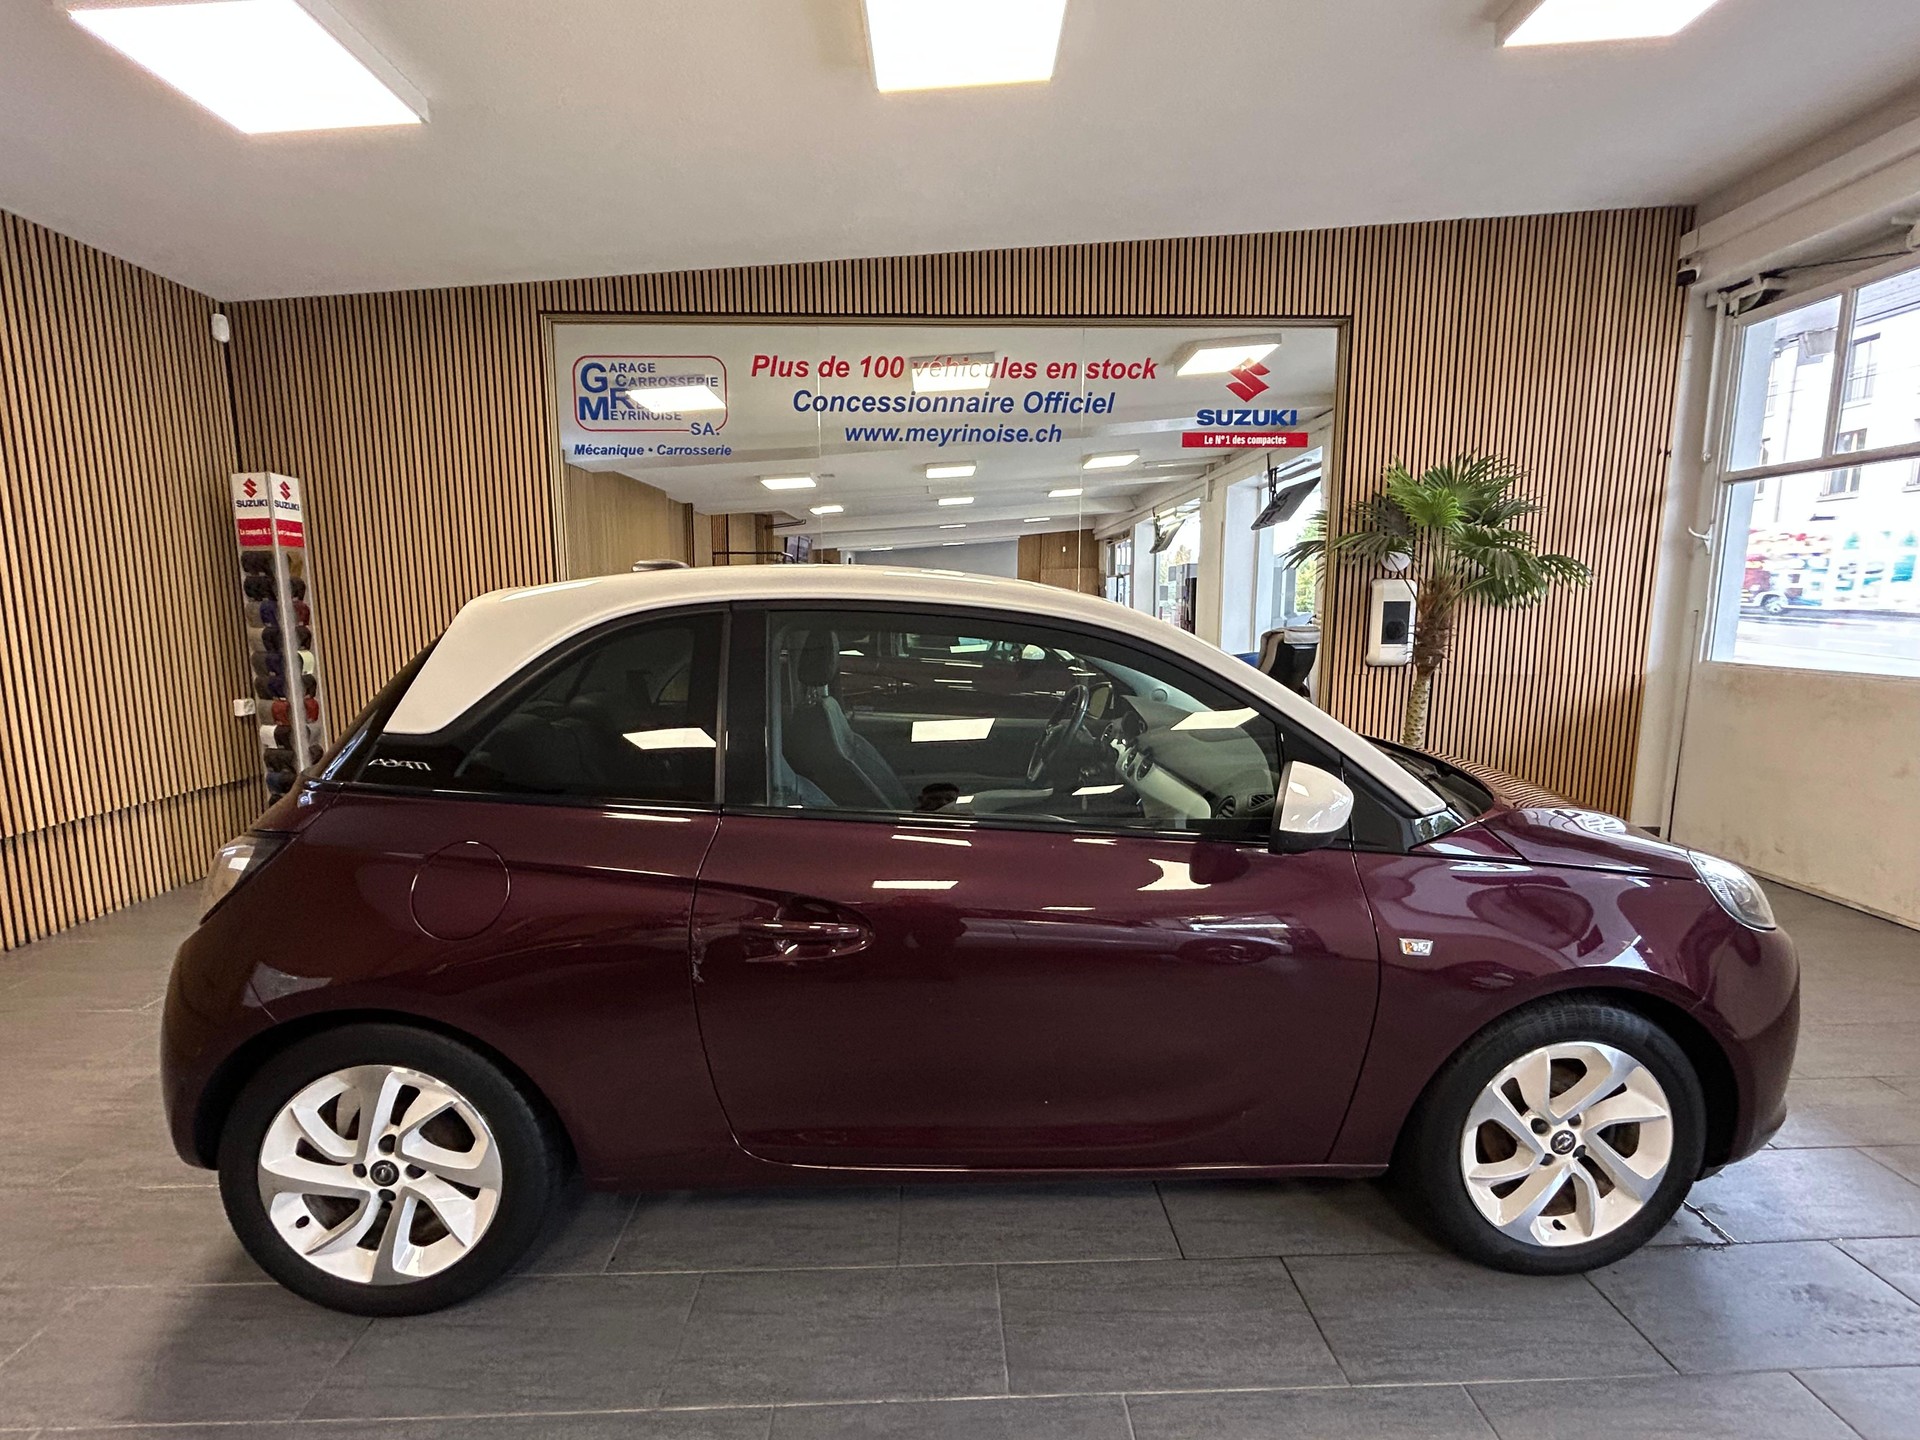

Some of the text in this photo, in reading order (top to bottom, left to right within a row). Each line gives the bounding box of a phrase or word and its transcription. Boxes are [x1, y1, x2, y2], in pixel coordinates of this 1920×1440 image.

[751, 355, 1159, 380] Plus de 100 véhicules en stock
[615, 374, 718, 388] CARROSSERIE
[793, 389, 1116, 414] Concessionnaire Officiel
[1196, 409, 1298, 427] SUZUKI
[845, 423, 1062, 447] www.meyrinoise.ch
[1204, 435, 1213, 445] Le
[1232, 435, 1246, 445] des
[1247, 435, 1287, 446] compactes
[574, 443, 732, 458] Mécanique Carrosserie
[236, 499, 268, 508] SUZUKI
[274, 500, 300, 512] SUZUKI
